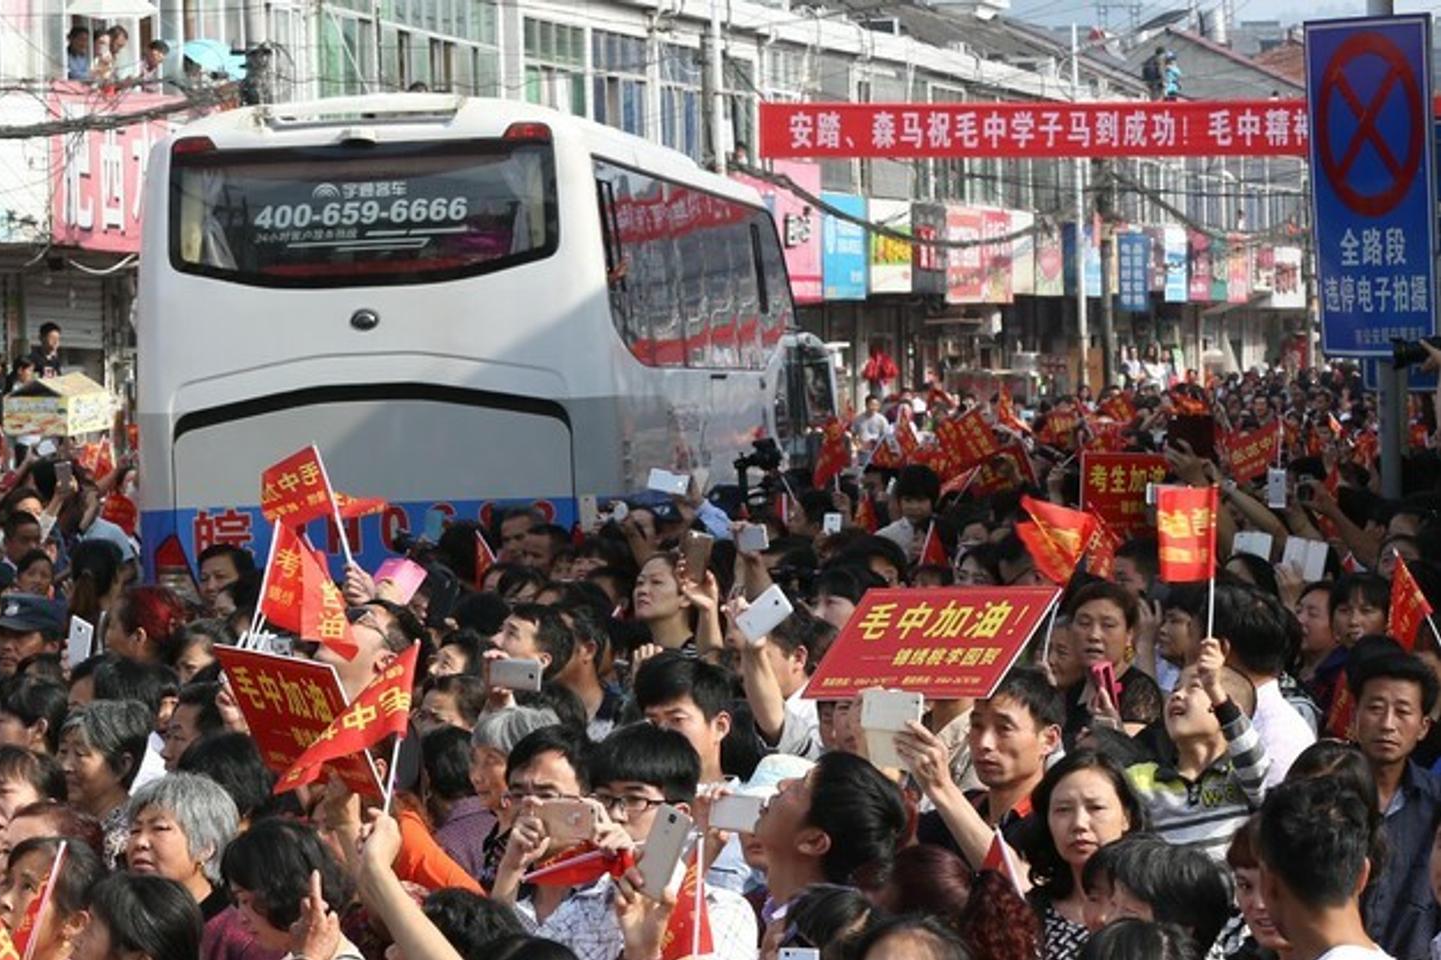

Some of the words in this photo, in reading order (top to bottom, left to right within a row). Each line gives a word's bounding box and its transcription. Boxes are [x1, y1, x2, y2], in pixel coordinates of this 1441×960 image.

[254, 197, 468, 229] 400-659-6666
[1340, 227, 1407, 267] 全路段
[858, 600, 1029, 641] 毛中加油!
